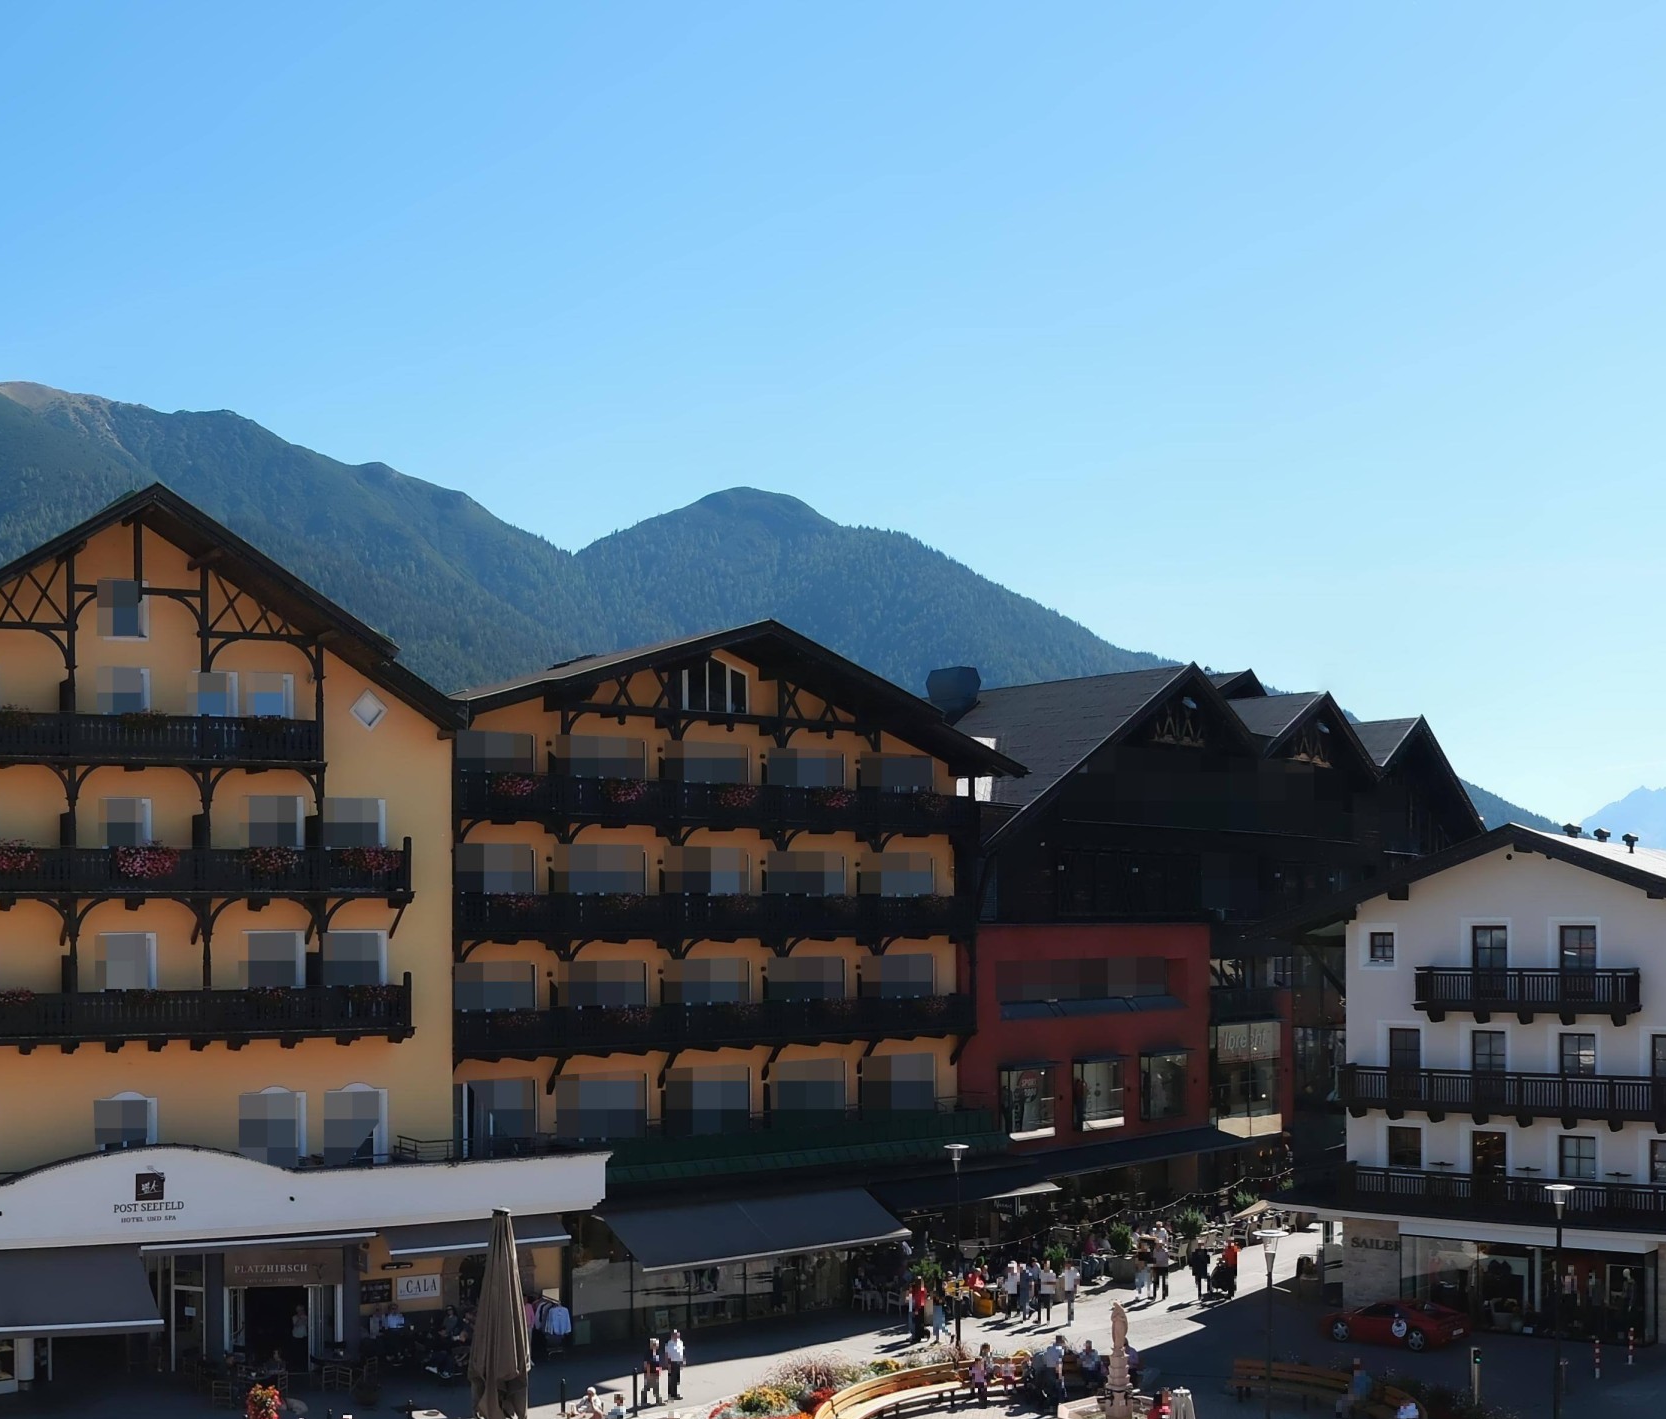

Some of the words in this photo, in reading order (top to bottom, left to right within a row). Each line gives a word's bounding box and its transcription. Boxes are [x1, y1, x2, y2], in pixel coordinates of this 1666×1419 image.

[113, 1203, 139, 1213] POST
[140, 1201, 184, 1212] SEEFELD
[234, 1263, 308, 1274] PLATZHIRSCH
[406, 1278, 437, 1294] CALA
